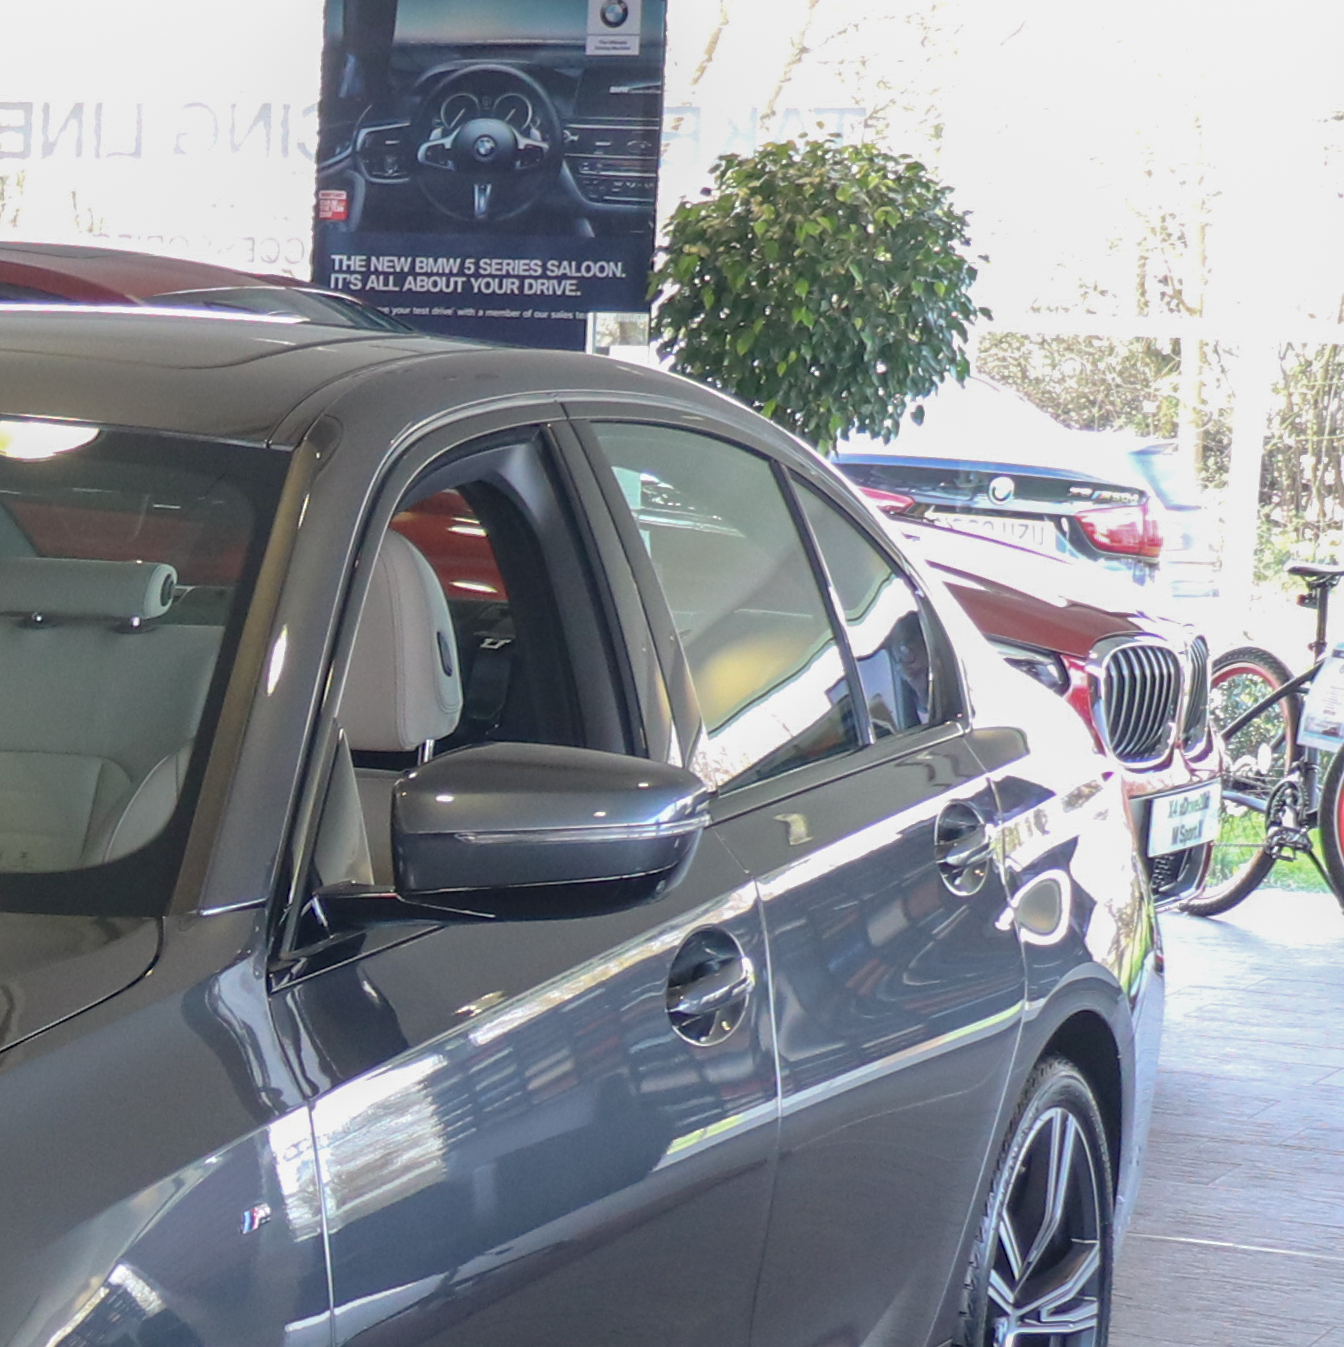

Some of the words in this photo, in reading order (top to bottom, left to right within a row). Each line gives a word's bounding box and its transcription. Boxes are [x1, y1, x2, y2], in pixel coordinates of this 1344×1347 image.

[330, 254, 367, 272] THE
[370, 255, 412, 273] NEW
[415, 257, 461, 274] BMW
[464, 258, 475, 275] 5
[478, 258, 542, 277] SERIES
[546, 260, 626, 278] SALOON.
[330, 273, 362, 290] IT'S
[365, 275, 400, 291] ALL
[403, 276, 467, 293] ABOUT
[470, 277, 519, 295] YOUR
[523, 279, 581, 296] DRIVE.
[391, 306, 412, 316] your
[413, 306, 430, 316] test
[456, 307, 476, 317] with
[485, 308, 521, 318] member
[522, 308, 533, 318] of
[534, 310, 549, 319] our
[550, 310, 574, 319] sales
